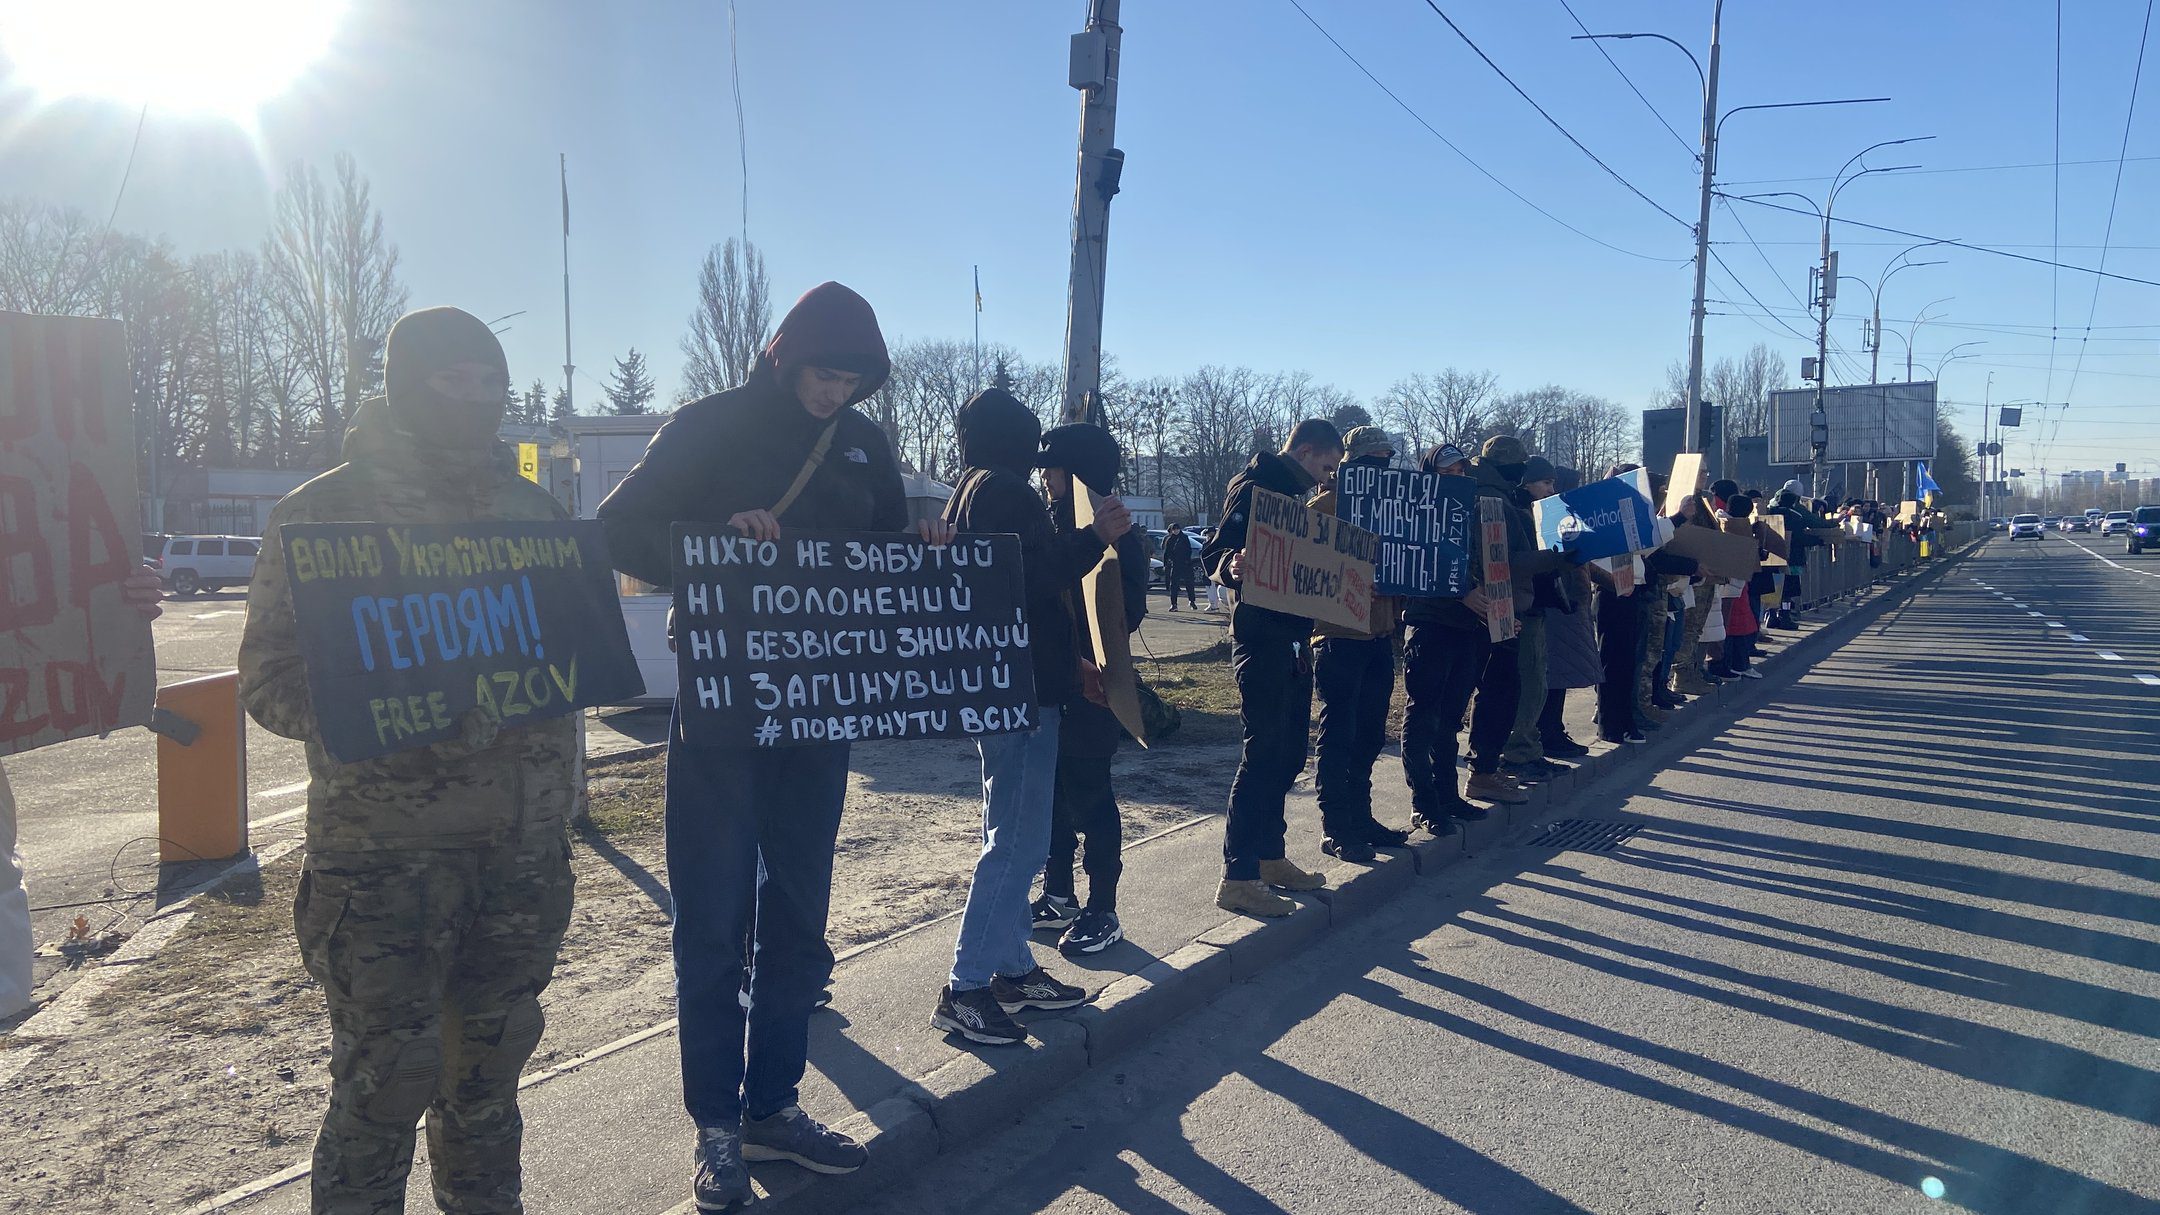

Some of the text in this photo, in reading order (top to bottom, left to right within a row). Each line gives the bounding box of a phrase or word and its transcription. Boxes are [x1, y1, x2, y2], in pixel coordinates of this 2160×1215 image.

[1255, 491, 1309, 539] БОРЕМОСЬ
[1313, 513, 1330, 545] ЗА
[1351, 496, 1364, 527] НЕ
[291, 535, 385, 582] ВОЛЮ
[683, 535, 993, 573] НІХТО НЕ ЗАБУТИЙ
[1247, 524, 1295, 595] AZOV
[687, 573, 972, 616] НІ ПОЛОНЕНИЙ
[352, 575, 544, 672] ГЕРОЯМ!
[690, 608, 1030, 661] НІ БЕЗВІСТИ ЗНИКЛИЙ
[369, 653, 577, 747] FREE AZOV
[696, 651, 1010, 710] НІ ЗАГИНУВШИЙ
[960, 702, 1030, 733] ВСІХ
